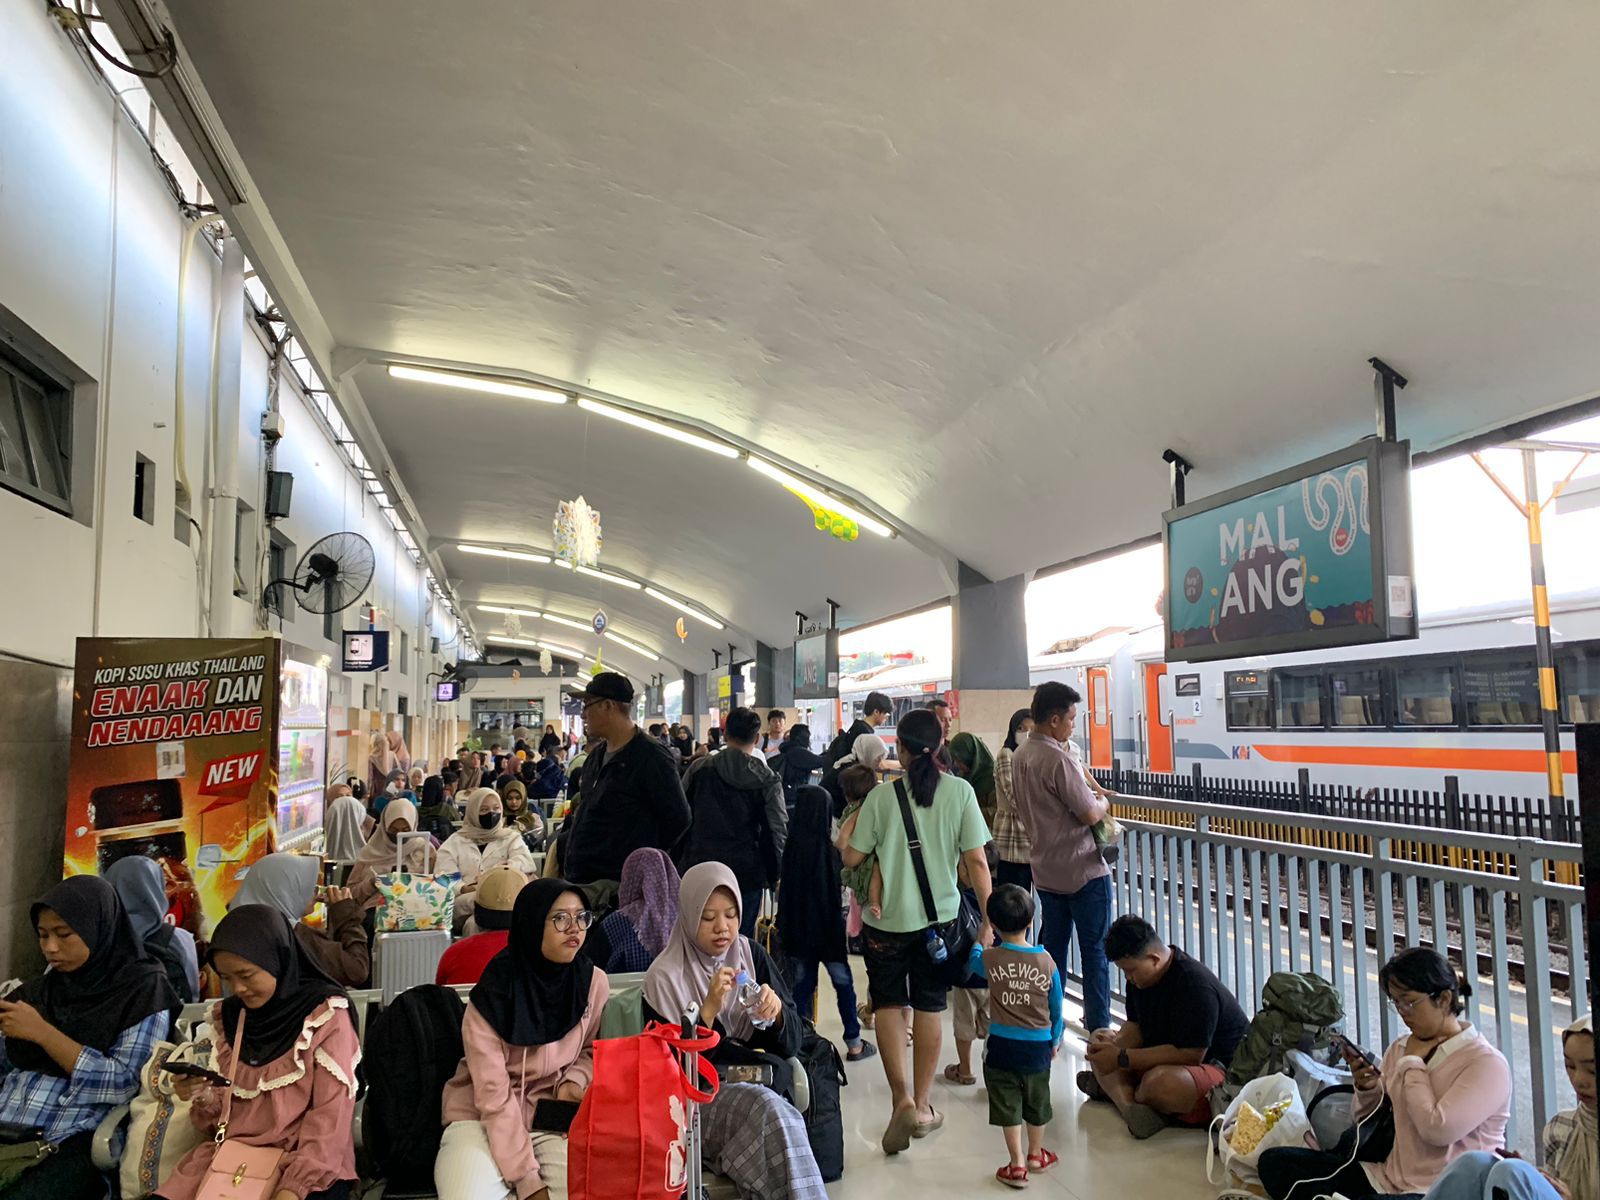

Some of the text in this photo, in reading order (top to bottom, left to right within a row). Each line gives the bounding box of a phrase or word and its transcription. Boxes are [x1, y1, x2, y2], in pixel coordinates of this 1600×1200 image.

[1219, 505, 1300, 567] MAL
[1220, 557, 1304, 618] ANG
[94, 655, 265, 684] KOPI SUSU KHAS THAILAND
[91, 674, 263, 717] ENAAK DAN
[1194, 702, 1200, 712] 2
[88, 706, 263, 747] NENDAAANG
[206, 755, 259, 787] NEW
[989, 963, 1051, 992] HAEWOOD
[1009, 980, 1030, 990] MADE
[1002, 992, 1030, 1005] 0028
